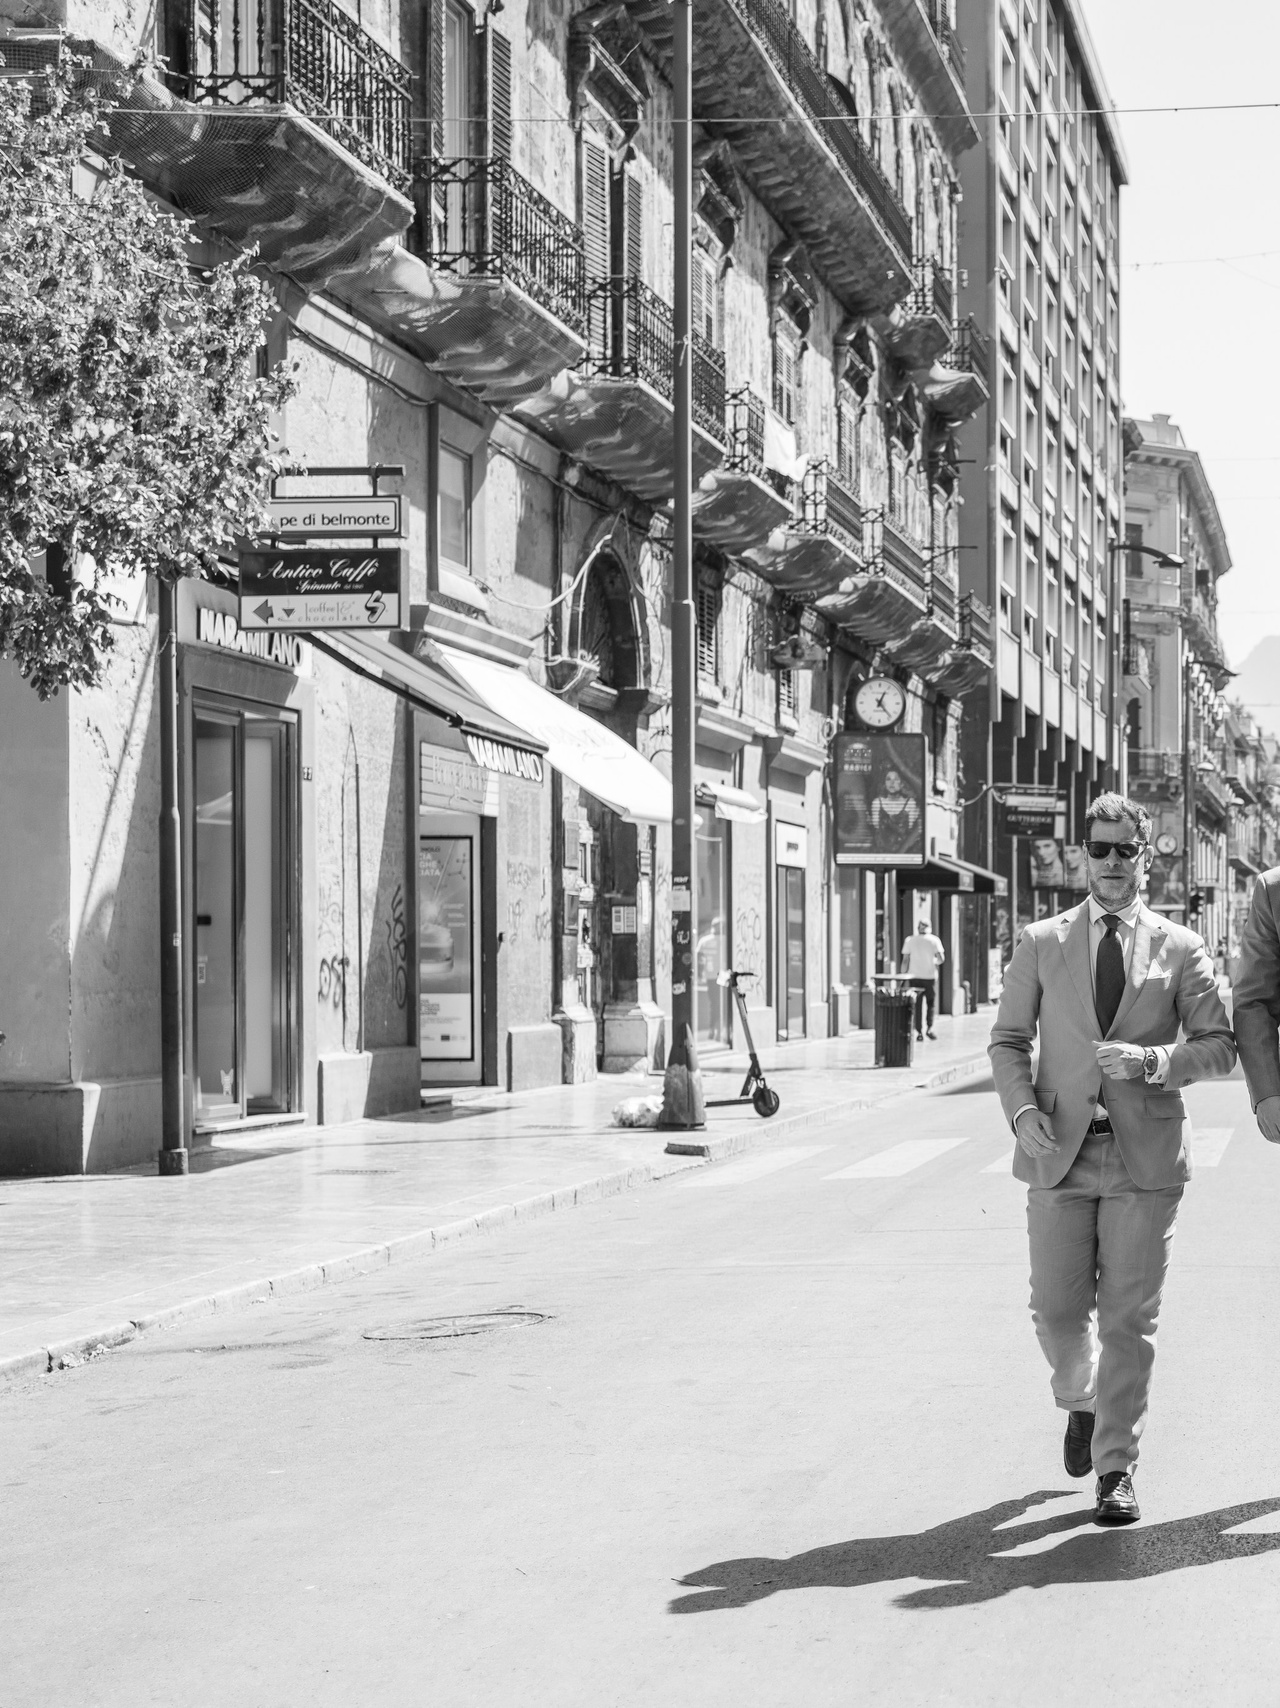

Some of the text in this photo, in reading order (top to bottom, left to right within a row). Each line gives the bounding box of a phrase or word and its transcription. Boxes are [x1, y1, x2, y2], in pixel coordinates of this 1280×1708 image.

[302, 513, 316, 526] di
[321, 513, 390, 527] belmonte
[257, 557, 380, 582] Antico Caffè
[309, 602, 336, 613] coffee
